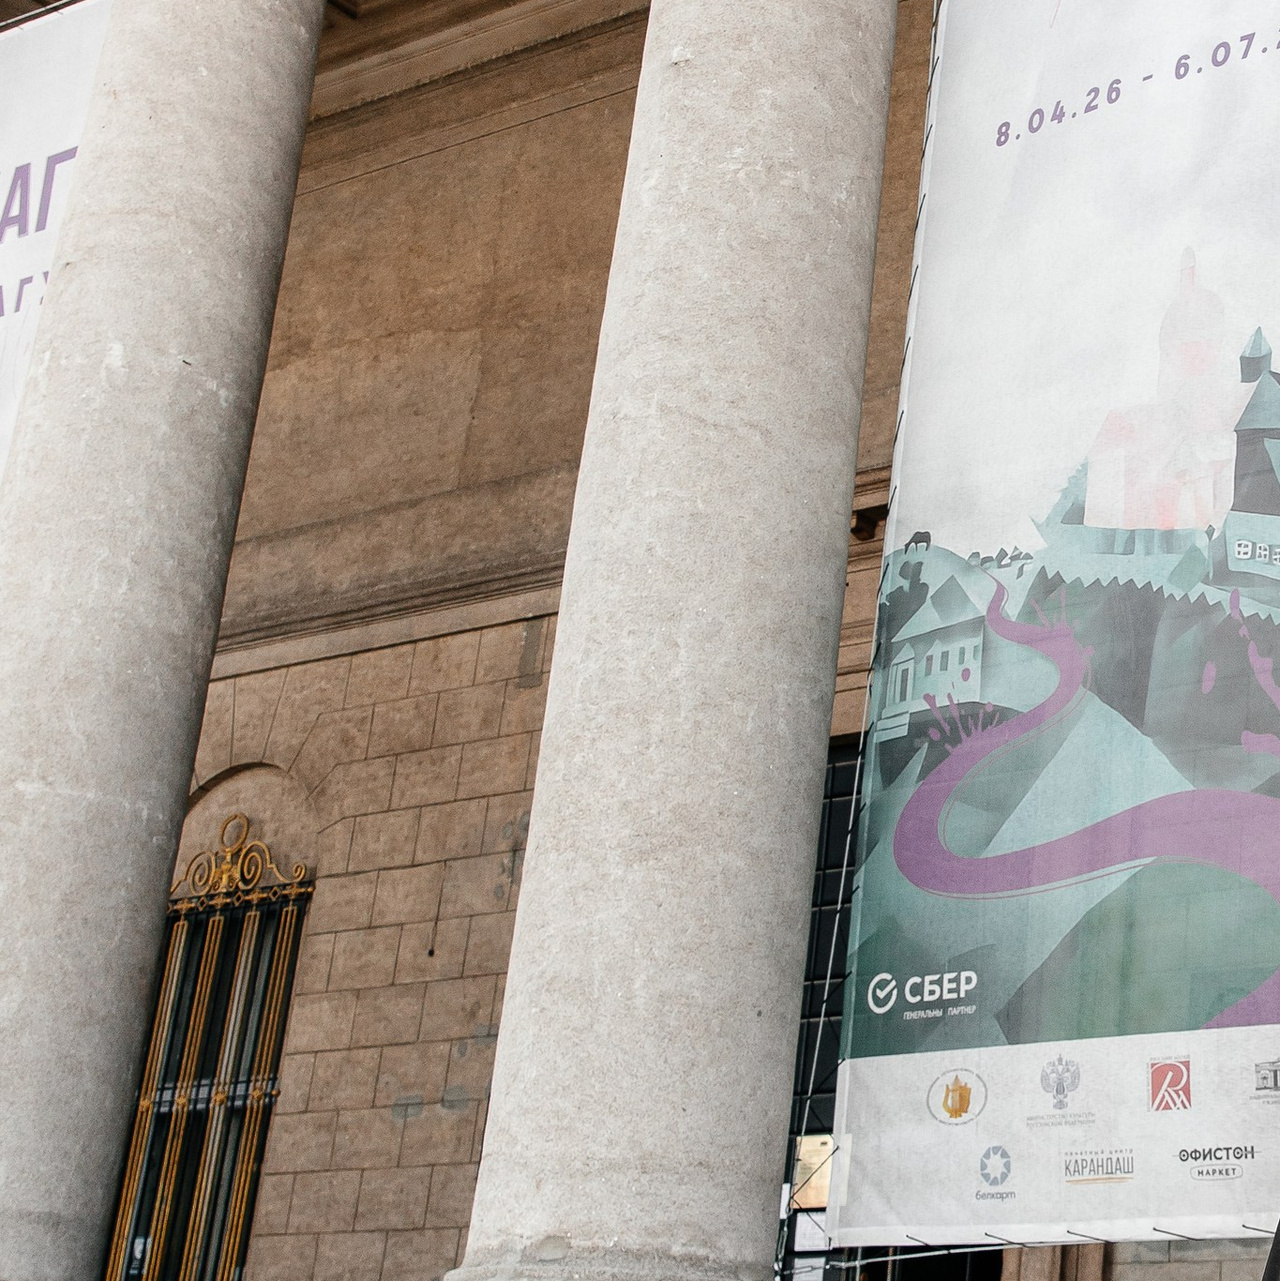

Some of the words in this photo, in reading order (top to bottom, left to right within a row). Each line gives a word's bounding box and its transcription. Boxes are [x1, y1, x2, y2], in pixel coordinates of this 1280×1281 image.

[996, 78, 1122, 147] 8.04.26
[904, 970, 978, 1004] СБЕР
[1178, 1145, 1255, 1162] ОФИСТОН
[1064, 1156, 1134, 1177] КАРАНДАШ
[1197, 1167, 1238, 1177] МАРКЕТ
